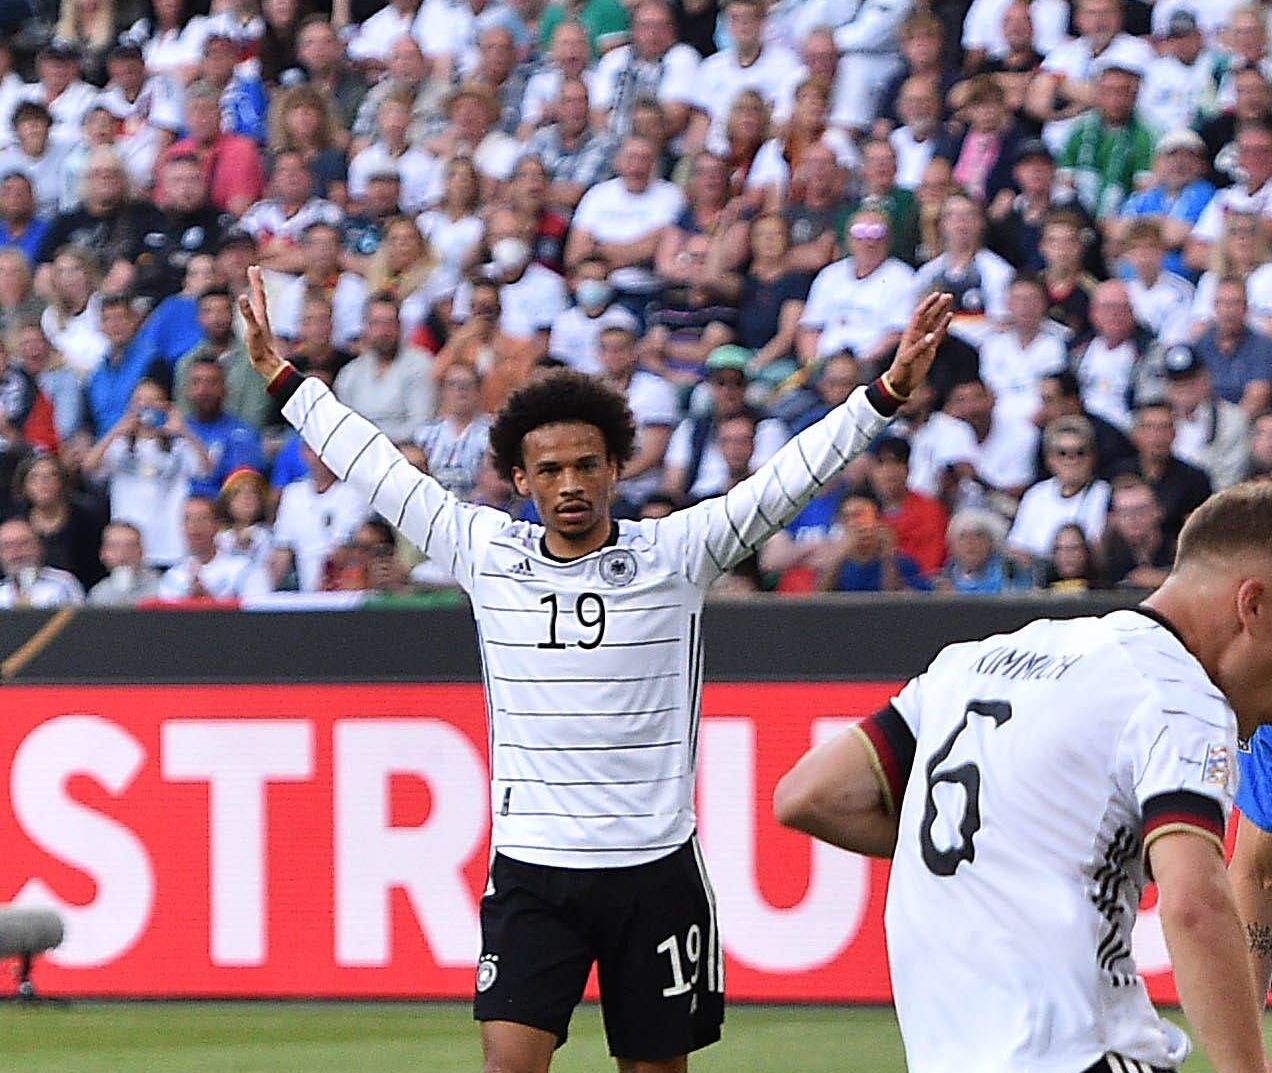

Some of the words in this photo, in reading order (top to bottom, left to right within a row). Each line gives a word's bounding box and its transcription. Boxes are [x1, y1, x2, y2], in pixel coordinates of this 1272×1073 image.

[537, 592, 606, 650] 19
[919, 698, 1013, 877] 6
[656, 924, 703, 1015] 19
